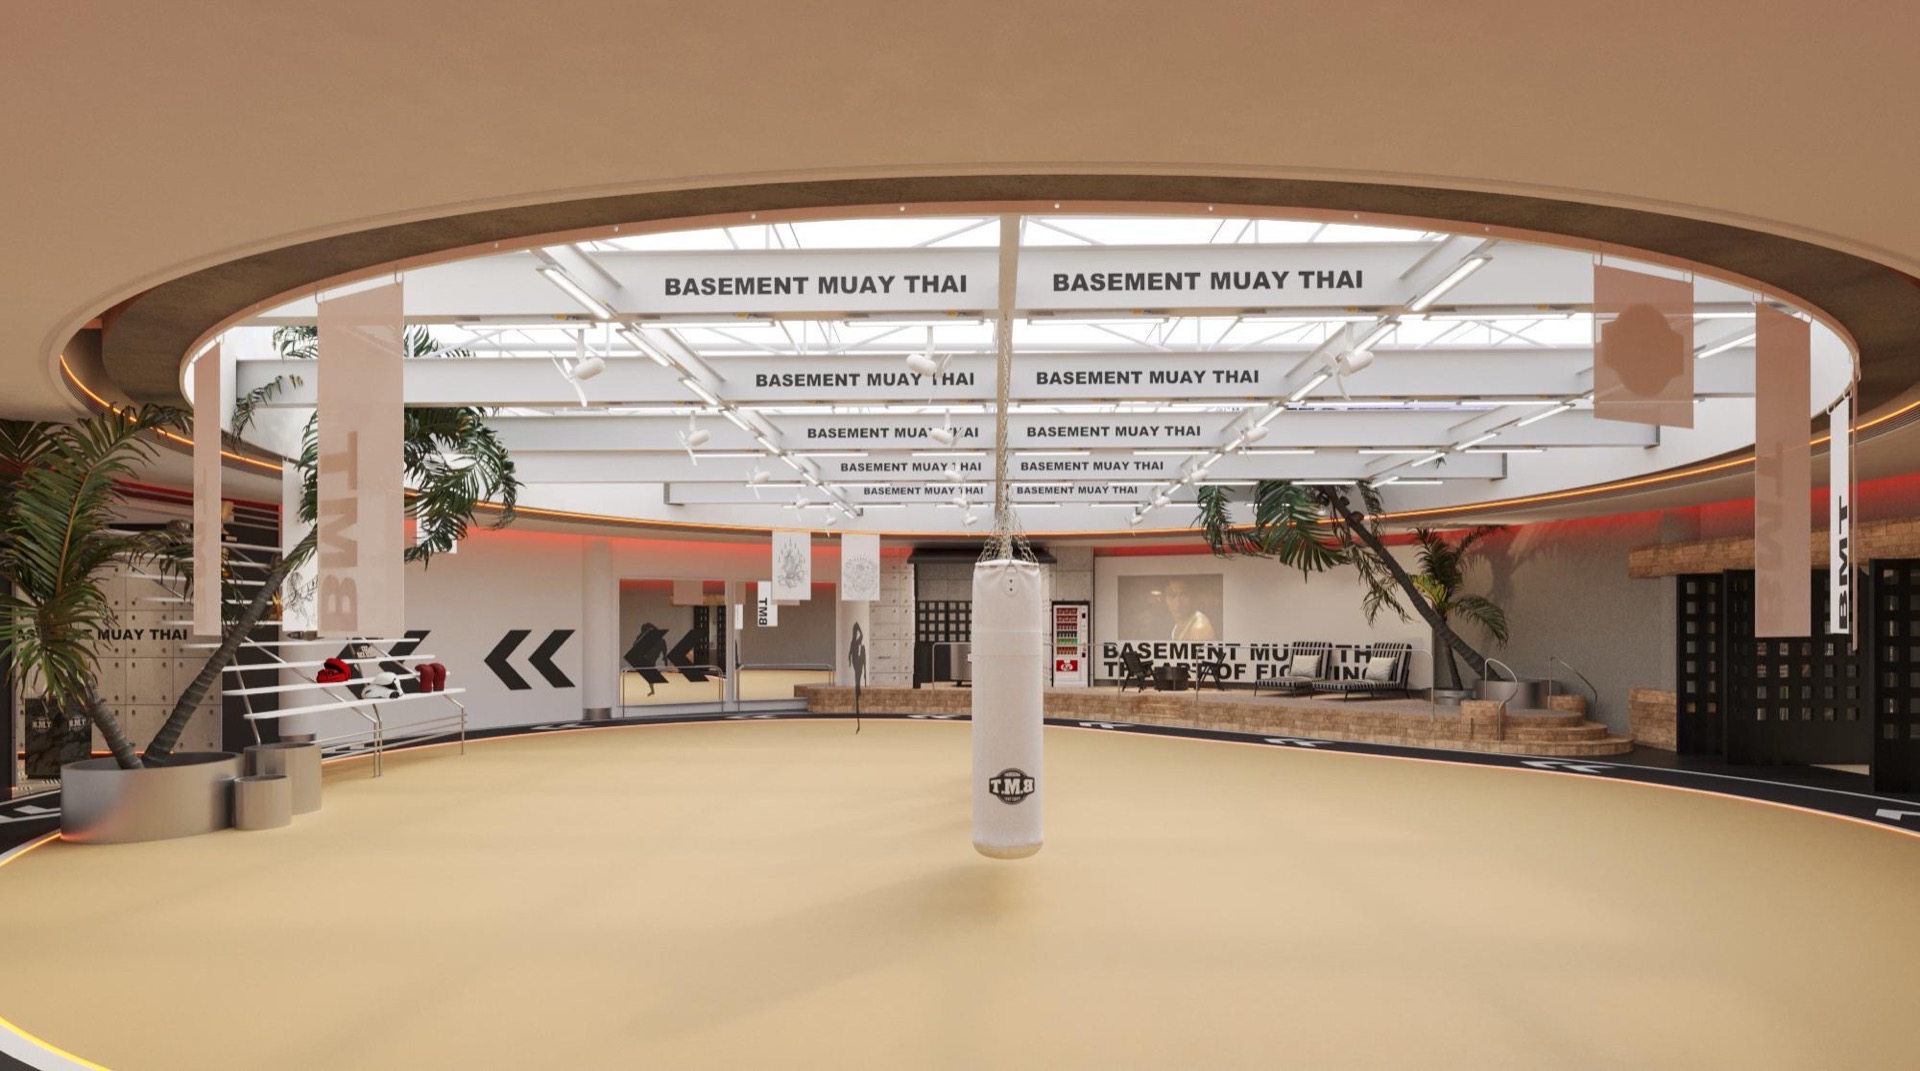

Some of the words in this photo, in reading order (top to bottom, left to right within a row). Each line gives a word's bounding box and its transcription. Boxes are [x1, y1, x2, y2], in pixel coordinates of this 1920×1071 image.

[664, 277, 809, 296] BASEMENT
[818, 275, 896, 295] MUAY
[903, 274, 967, 293] THAI
[1053, 272, 1201, 292] BASEMENT
[1210, 270, 1290, 290] MUAY
[1298, 270, 1363, 289] THAI
[755, 373, 861, 388] BASEMENT
[867, 373, 923, 387] MUAY
[1036, 371, 1143, 385] BASEMENT
[1149, 370, 1207, 384] MUAY
[1212, 370, 1259, 384] THAI
[807, 427, 890, 439] BASEMENT
[894, 427, 933, 438] MUA
[1026, 426, 1111, 438] BASEMENT
[1115, 425, 1160, 437] MUAY
[1164, 425, 1201, 437] THAI
[840, 462, 908, 472] BASEMENT
[912, 462, 948, 472] MUAY
[1020, 461, 1090, 471] BASEMENT
[1093, 461, 1130, 471] MUAY
[1133, 461, 1164, 471] THAI
[863, 486, 922, 495] BASEMENT
[924, 486, 955, 495] MUAY
[1016, 486, 1075, 495] BASEMENT
[1077, 486, 1109, 495] MUAY
[1112, 486, 1138, 494] THAI
[1838, 495, 1849, 630] BMT
[98, 629, 145, 641] MUAY
[149, 629, 188, 641] THAI
[1103, 642, 1241, 661] BASEMENT
[1250, 643, 1289, 662] MU
[1335, 644, 1372, 663] TH
[1218, 663, 1247, 680] OF
